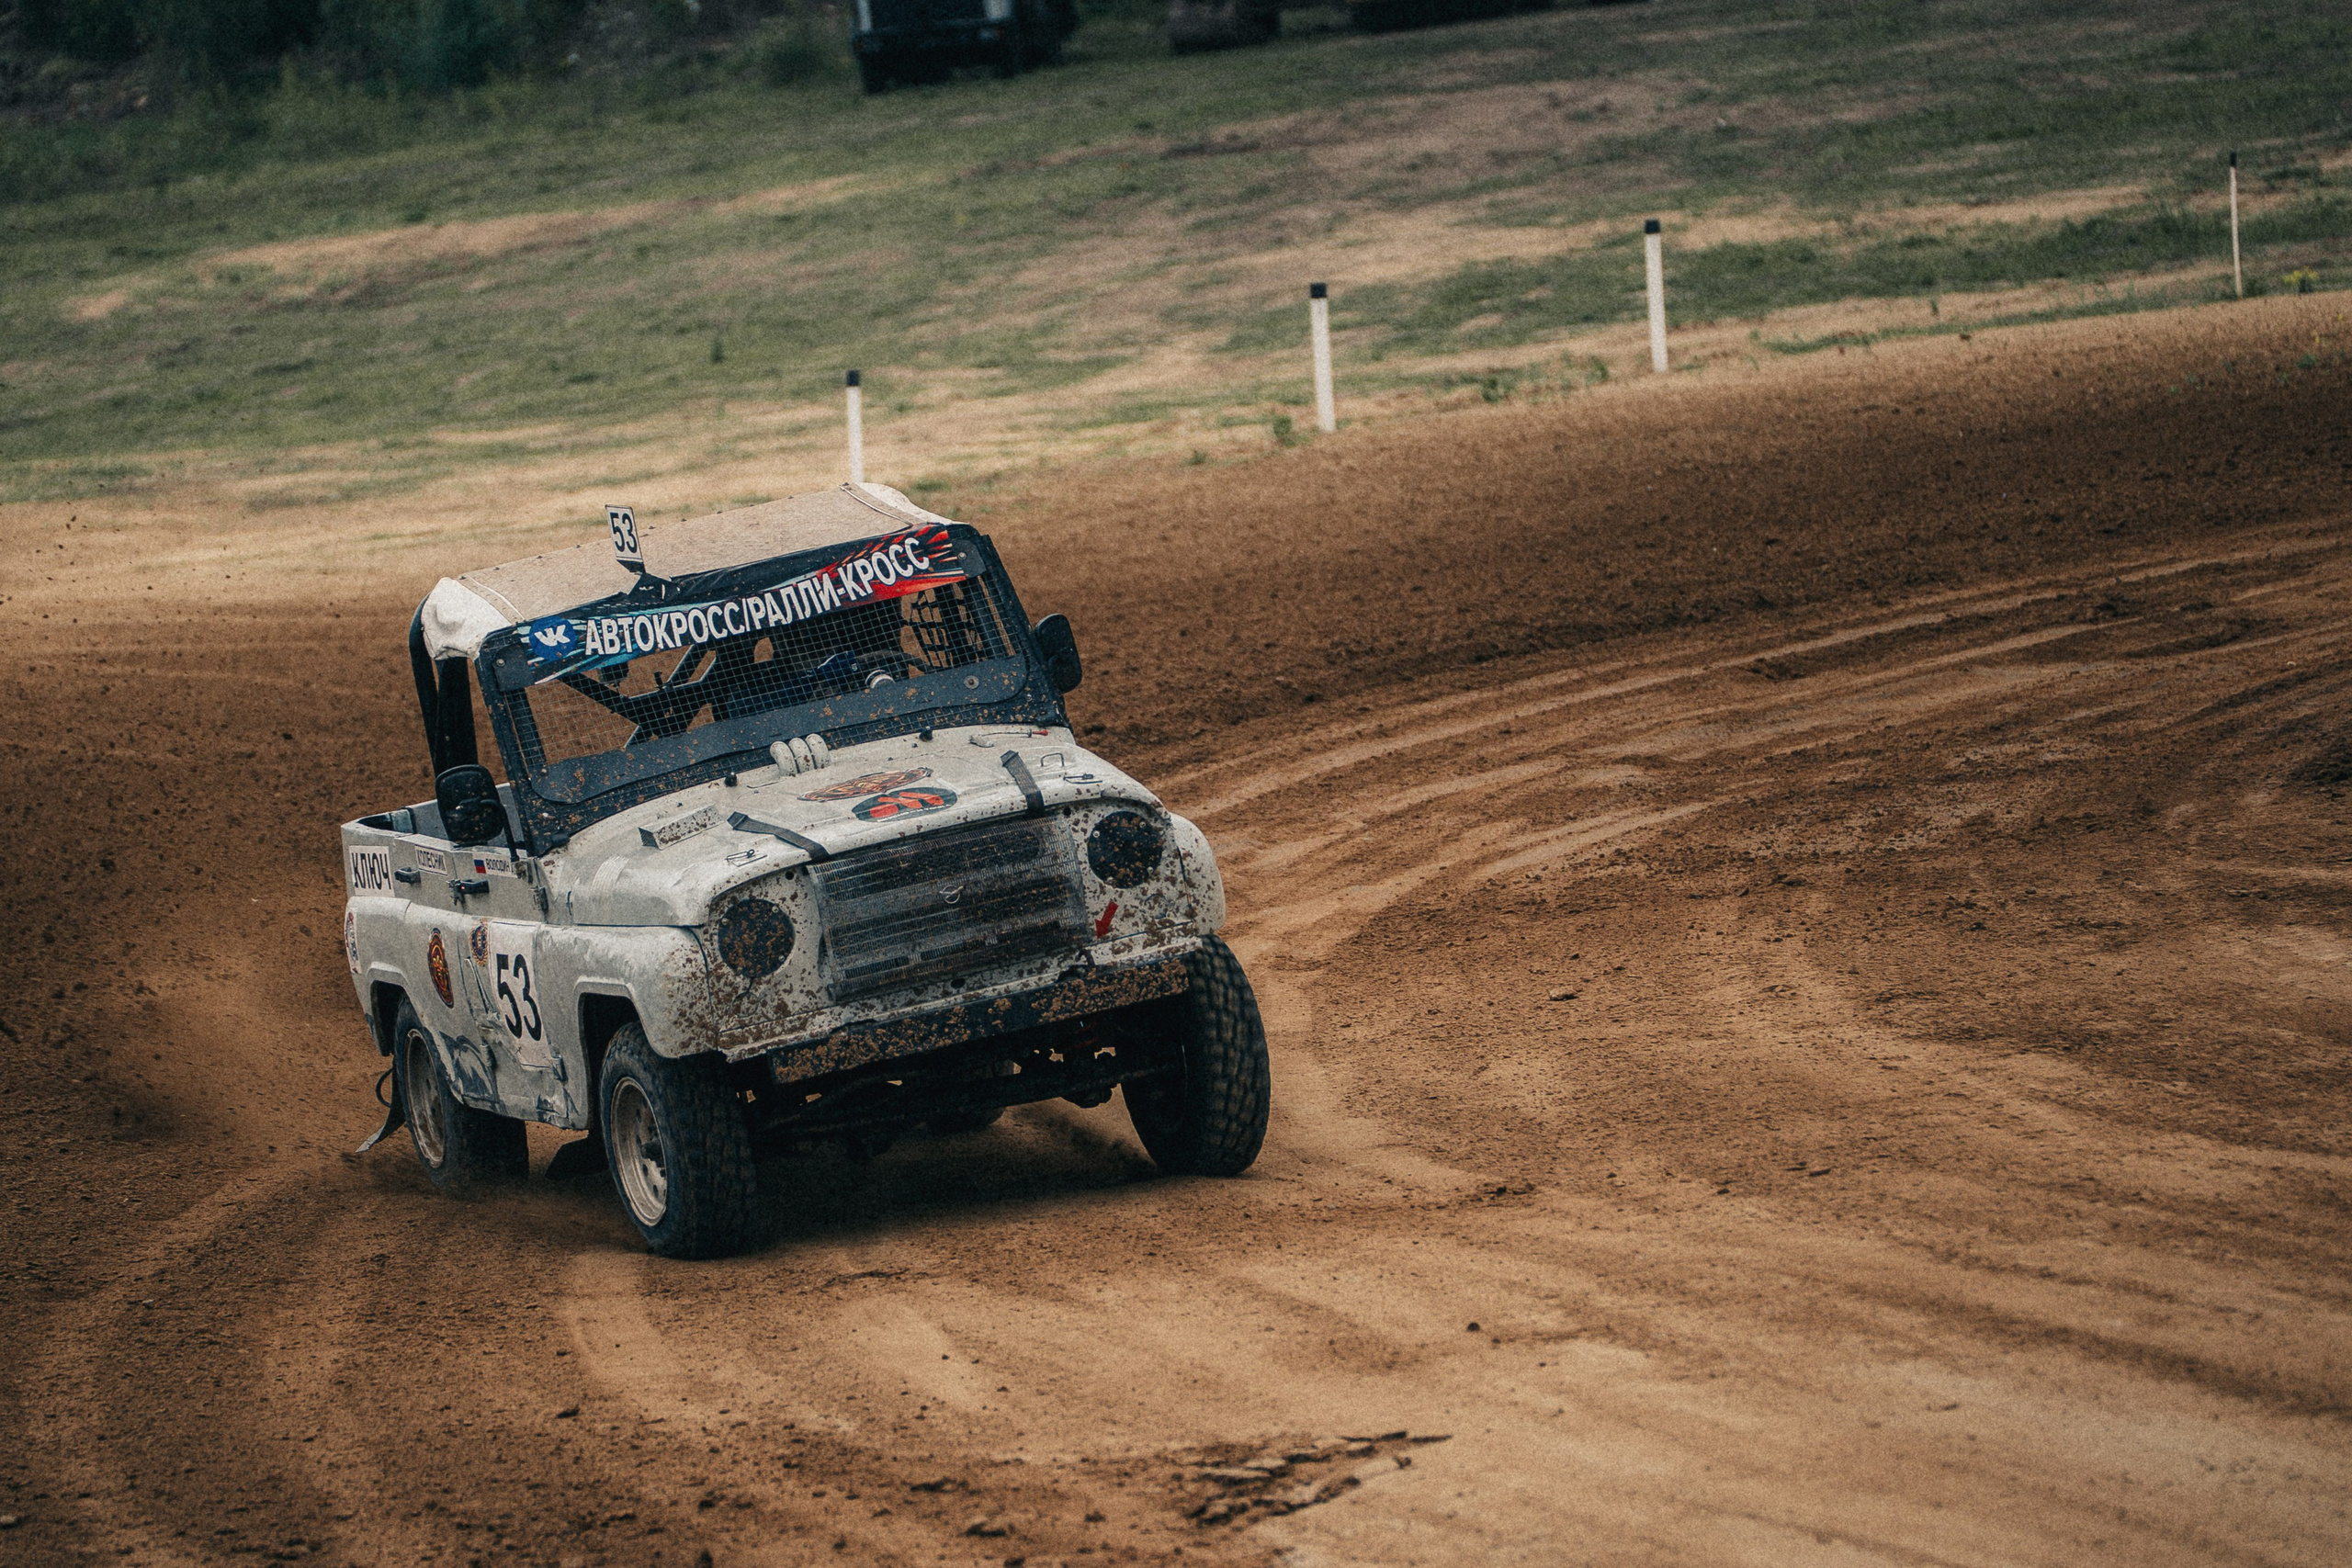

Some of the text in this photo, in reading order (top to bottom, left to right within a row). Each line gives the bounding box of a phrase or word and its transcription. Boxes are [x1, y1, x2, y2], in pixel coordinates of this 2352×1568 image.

[610, 512, 638, 554] 53
[585, 536, 930, 656] АВТОКРОСС/РАЛЛИ-КРОСС
[351, 852, 391, 890] КЛЮЧ
[496, 953, 542, 1042] 53
